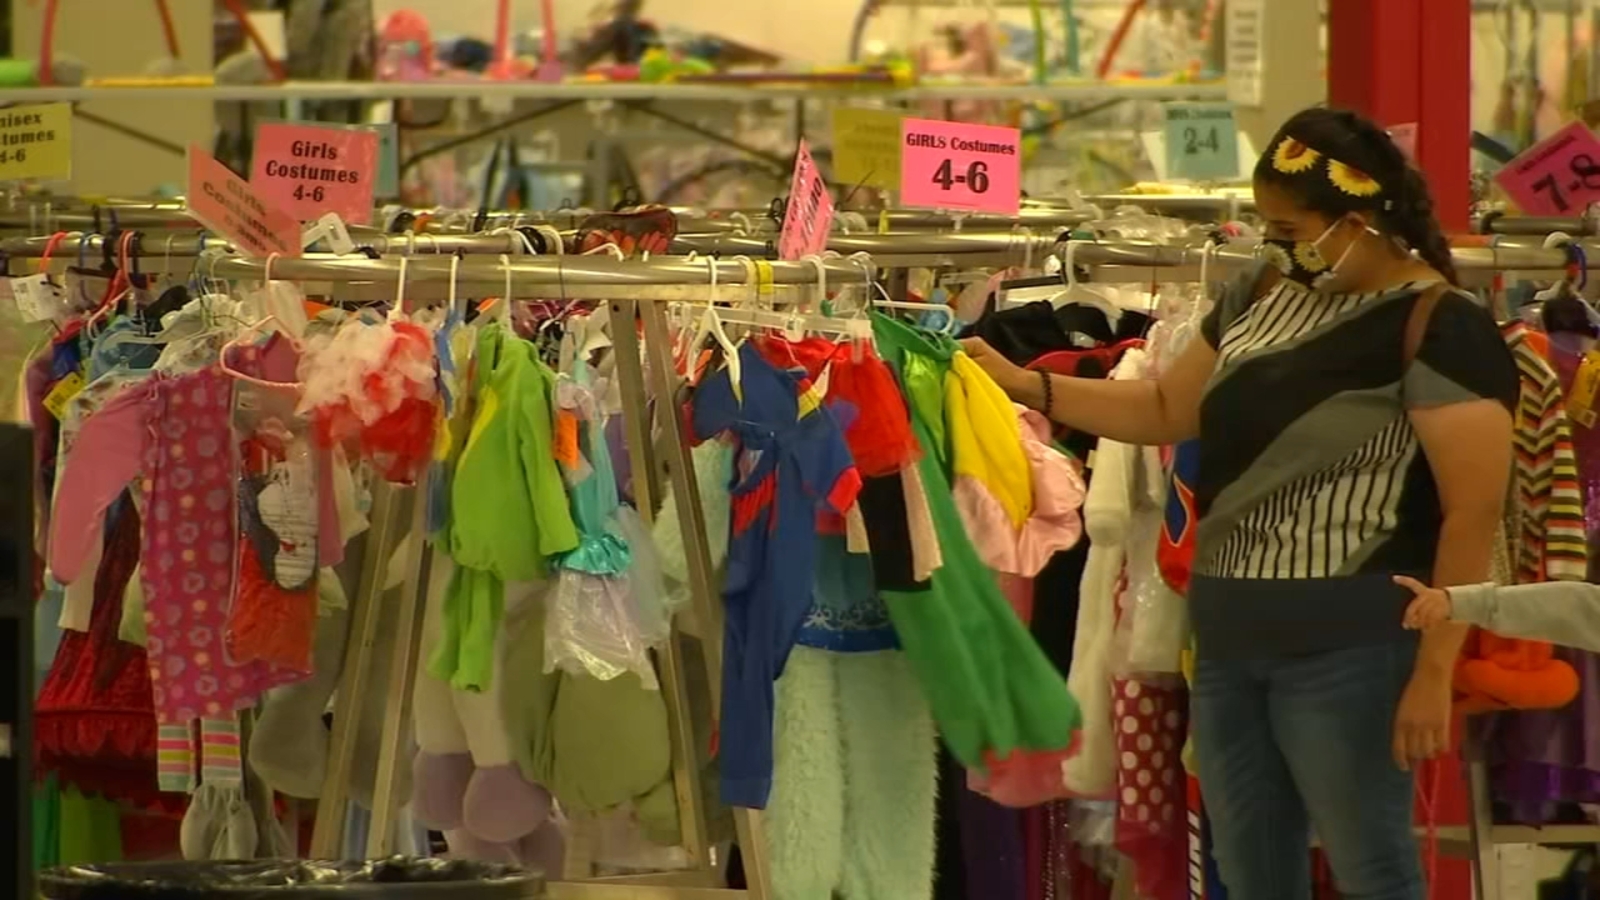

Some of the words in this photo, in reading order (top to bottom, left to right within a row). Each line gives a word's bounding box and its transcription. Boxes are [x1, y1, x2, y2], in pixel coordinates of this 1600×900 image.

[291, 140, 337, 160] Girls
[906, 133, 946, 149] GIRLS
[950, 137, 1015, 155] Costumes
[1184, 126, 1219, 154] 2-4
[266, 160, 359, 183] Costumes
[931, 159, 989, 194] 4-6
[1531, 153, 1600, 212] 7-8
[293, 184, 325, 202] 4-6
